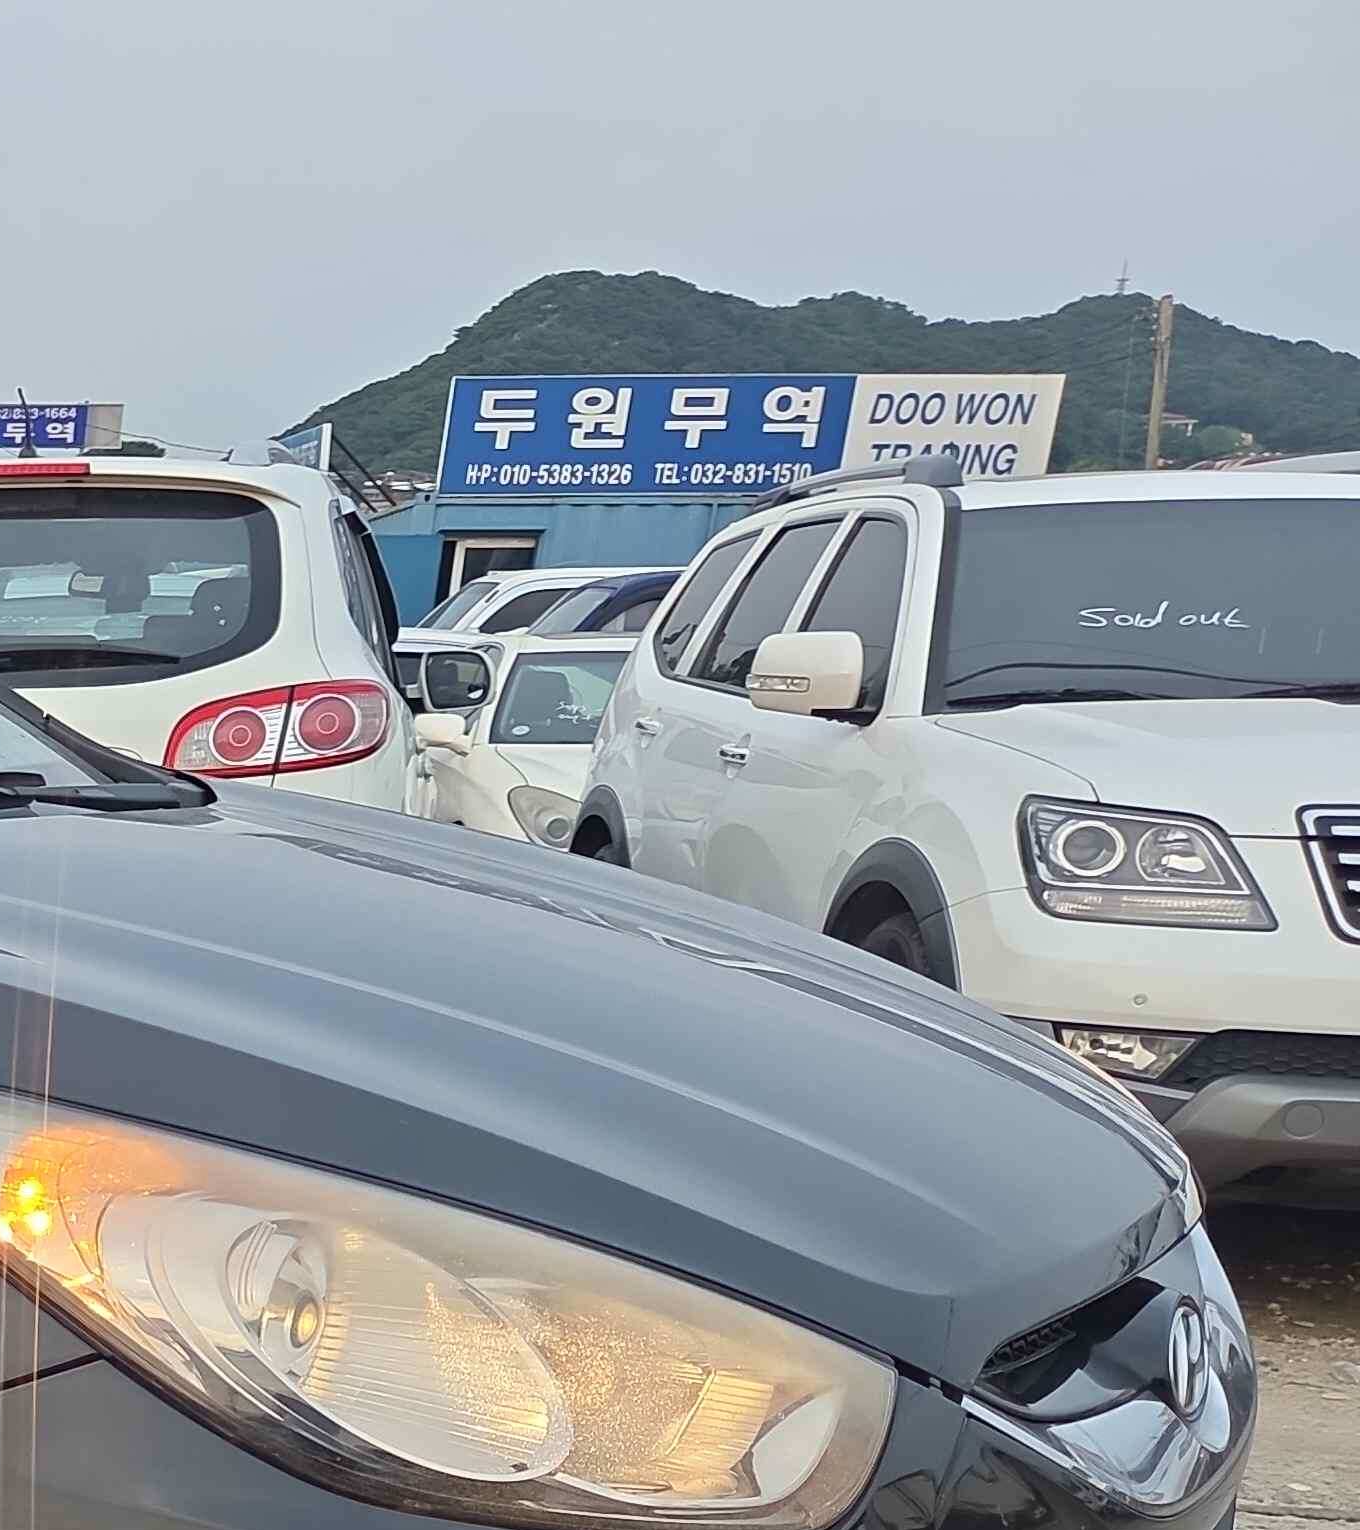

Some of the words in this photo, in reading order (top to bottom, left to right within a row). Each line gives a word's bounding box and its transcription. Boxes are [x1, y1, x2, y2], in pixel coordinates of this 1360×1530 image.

[868, 392, 946, 424] DOO
[954, 392, 1037, 424] WON
[1079, 600, 1169, 628] Sold
[1179, 608, 1250, 628] out
